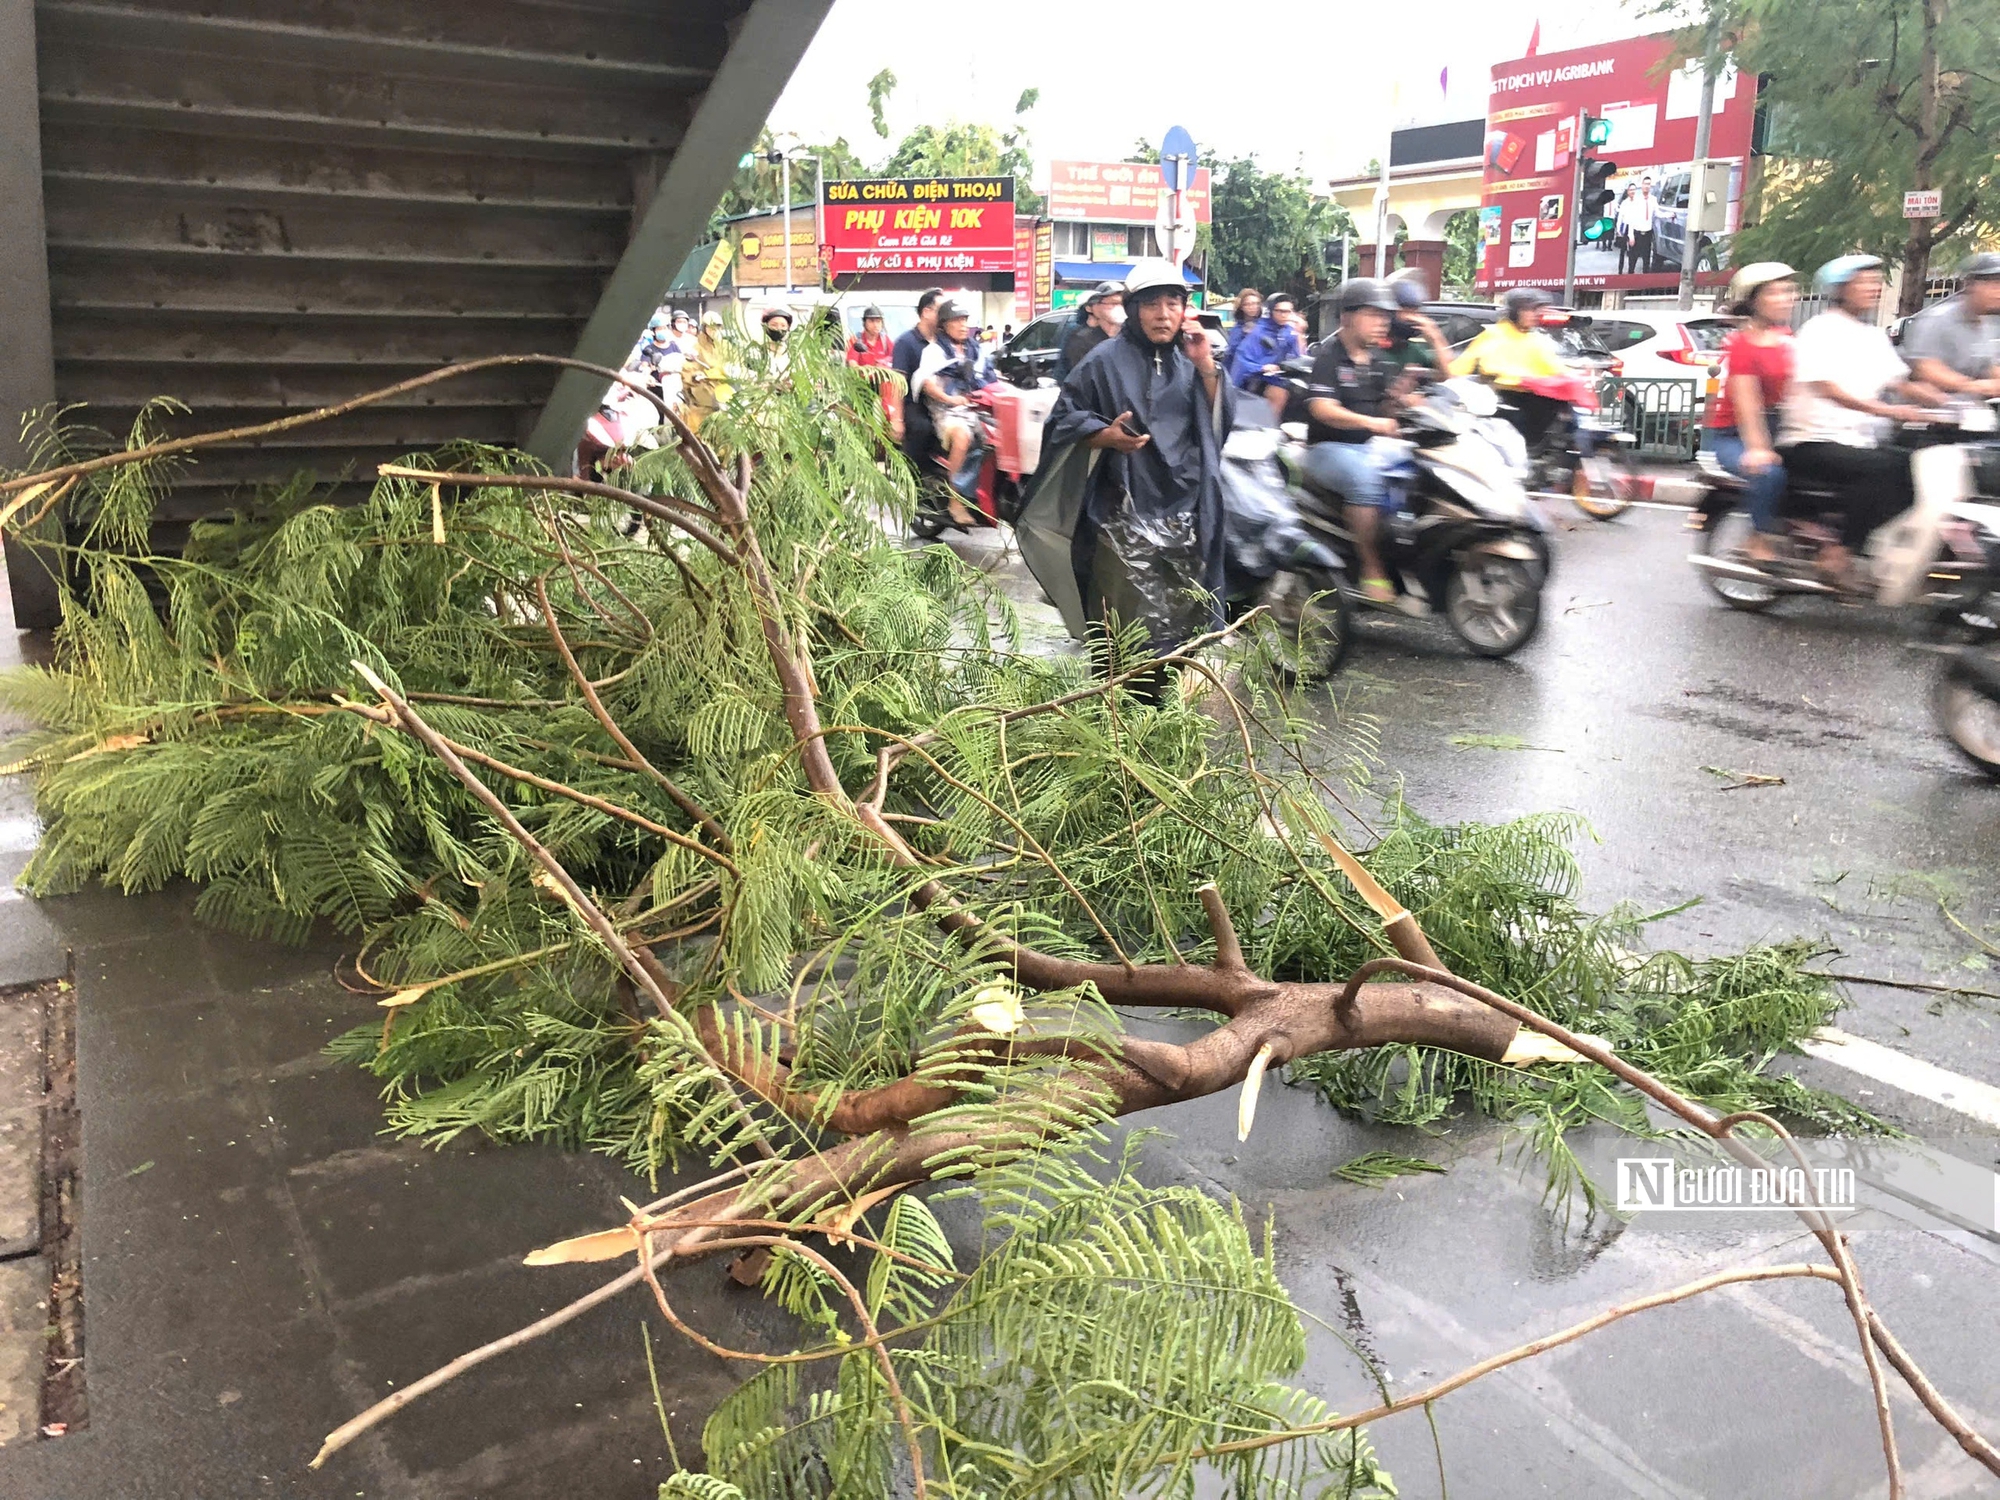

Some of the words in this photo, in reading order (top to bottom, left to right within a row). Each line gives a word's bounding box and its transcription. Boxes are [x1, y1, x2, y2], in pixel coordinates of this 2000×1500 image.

[1508, 72, 1535, 92] DỊCH
[1536, 69, 1553, 88] VỤ
[1553, 58, 1615, 82] AGRIBANK
[1067, 163, 1099, 181] THẾ
[862, 180, 909, 199] CHỮA
[913, 180, 949, 202] ĐIỆN
[952, 182, 1002, 202] THOẠI
[844, 209, 886, 235] PHỤ
[893, 203, 942, 234] KIỆN
[950, 207, 985, 229] 10K
[856, 252, 882, 269] MÁY
[883, 253, 902, 269] CŨ
[904, 256, 914, 268] &
[917, 256, 942, 271] PHỤ
[944, 252, 975, 271] KIỆN
